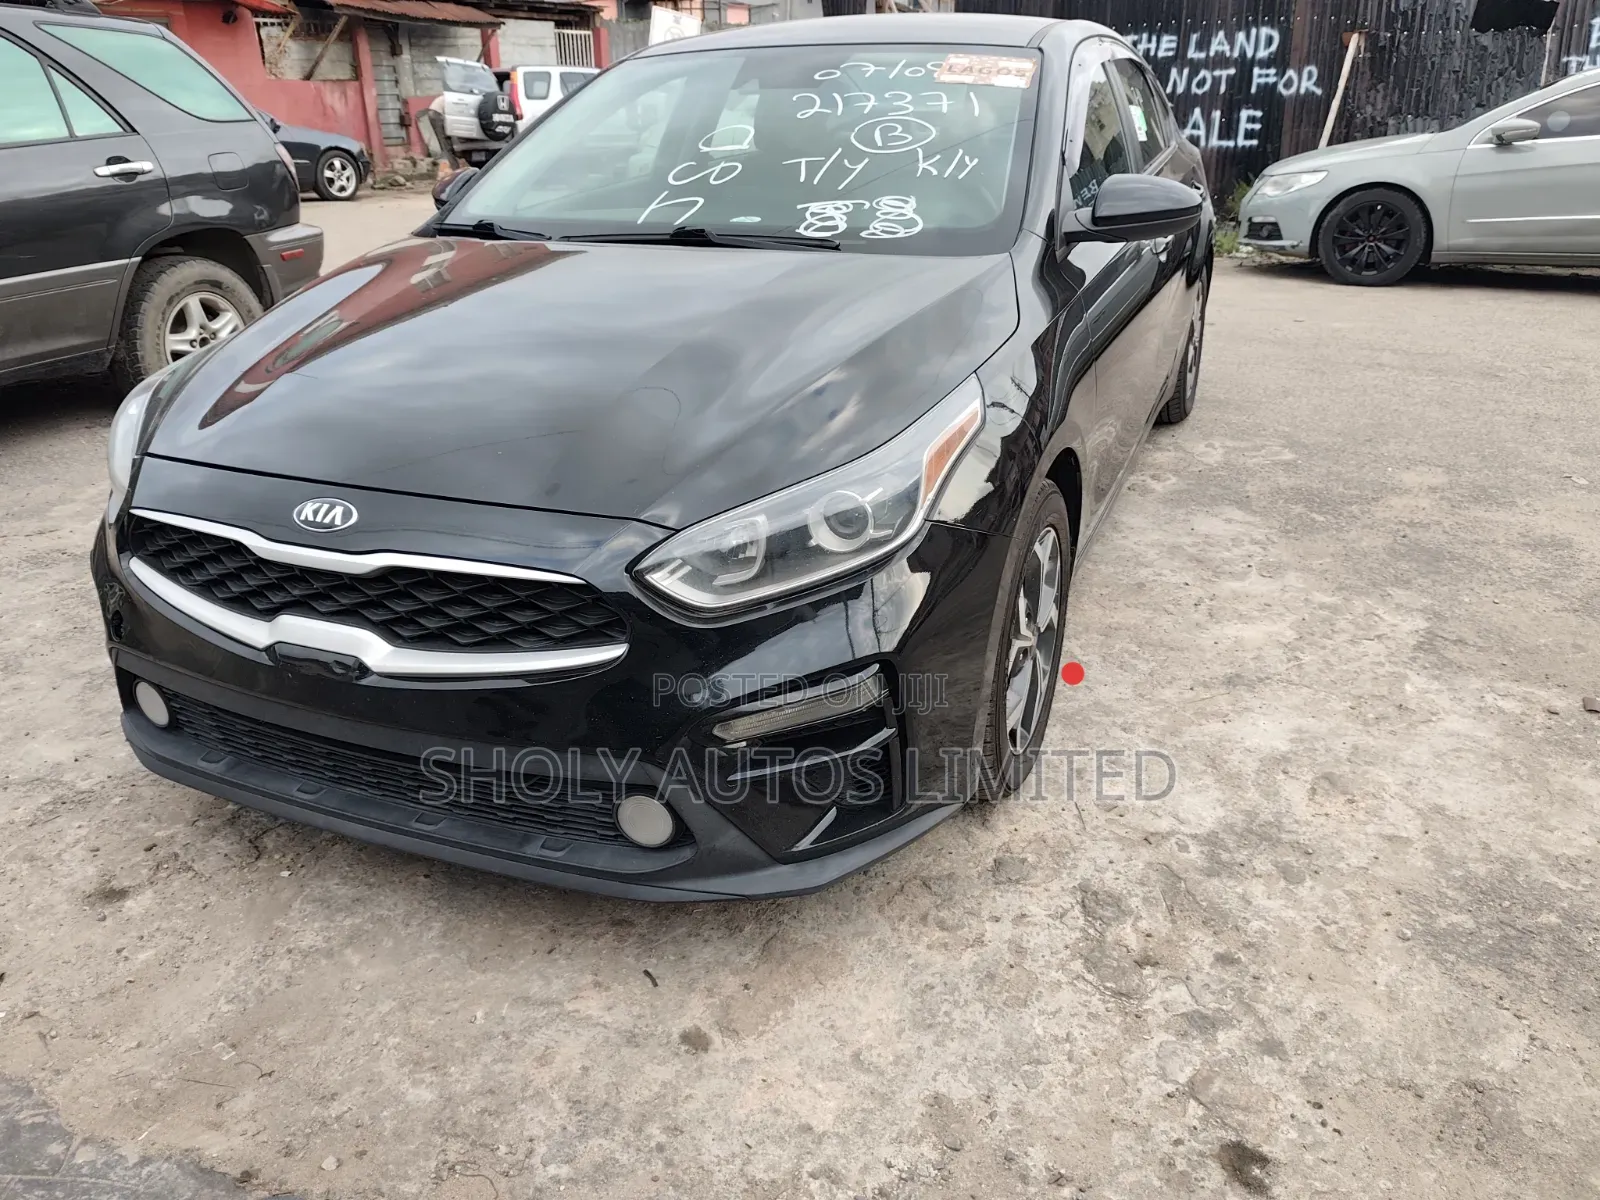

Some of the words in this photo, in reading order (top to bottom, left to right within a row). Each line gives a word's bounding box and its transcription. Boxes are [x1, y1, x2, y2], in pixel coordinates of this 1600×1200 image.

[1187, 26, 1280, 59] LAND
[945, 63, 1027, 78] LAGOS
[1166, 66, 1236, 95] NOT
[1250, 65, 1322, 96] FOR
[793, 91, 980, 119] 217371
[1183, 106, 1263, 148] ALE
[299, 502, 344, 525] KIA
